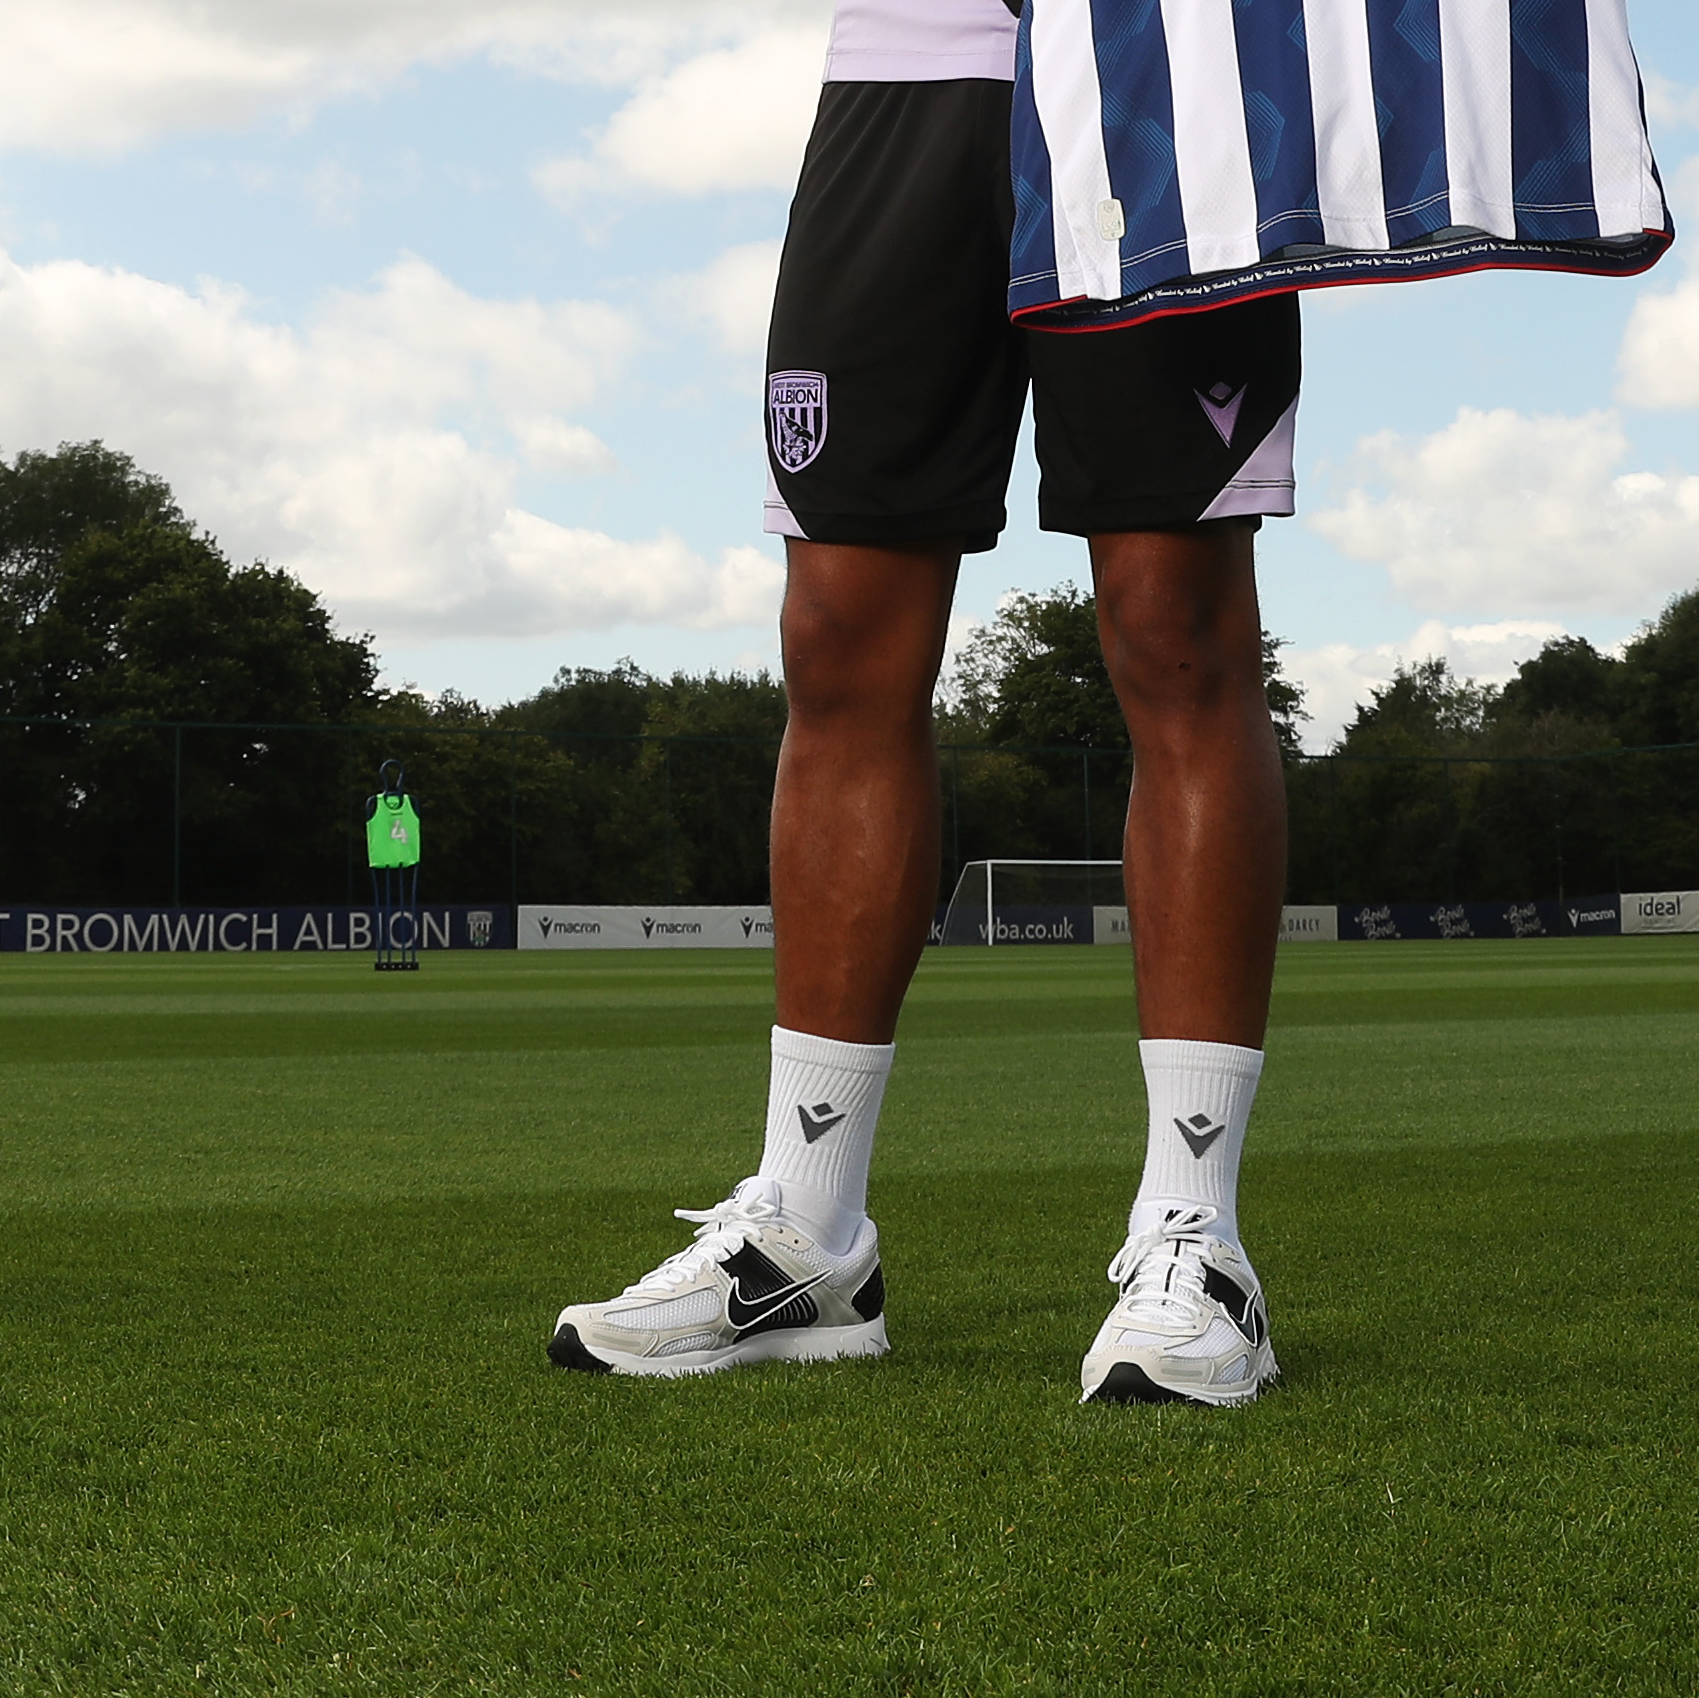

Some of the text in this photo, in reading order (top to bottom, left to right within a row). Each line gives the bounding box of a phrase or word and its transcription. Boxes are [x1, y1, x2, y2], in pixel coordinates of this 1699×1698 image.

[774, 389, 818, 404] ALBION
[391, 819, 408, 844] 4
[1638, 896, 1681, 916] ideal
[1580, 909, 1616, 922] macron
[26, 912, 279, 952] BROMWICH
[293, 912, 450, 950] ALBION
[554, 921, 600, 934] macron
[655, 921, 701, 934] macron
[979, 916, 1074, 940] wba.co.uk
[1288, 918, 1321, 932] DARCY
